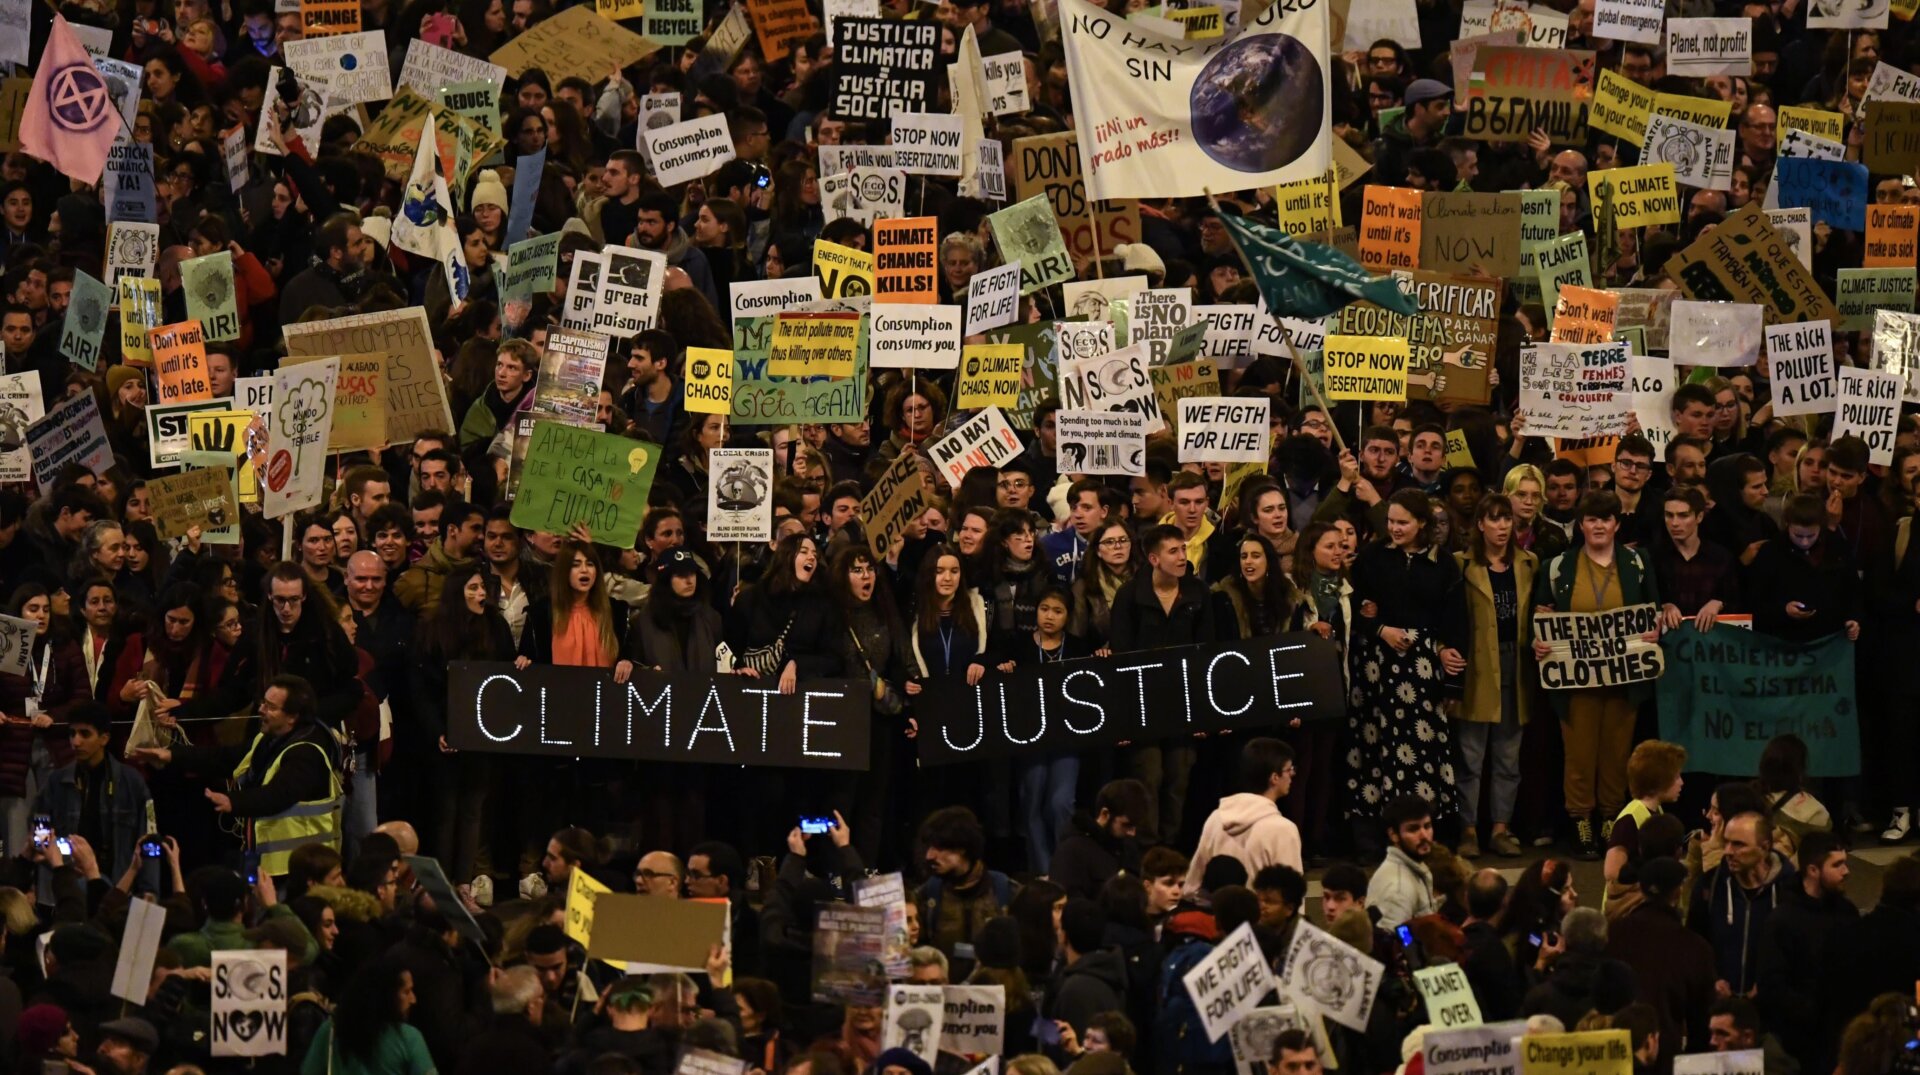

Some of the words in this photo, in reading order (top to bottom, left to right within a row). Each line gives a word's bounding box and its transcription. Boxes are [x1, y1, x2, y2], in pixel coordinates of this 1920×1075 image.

[304, 9, 358, 27] CHANGE
[649, 19, 701, 36] RECYCLE.
[1072, 14, 1112, 40] NO
[1597, 10, 1619, 26] global
[842, 22, 936, 44] JUSTICIA
[1531, 25, 1566, 47] UP!
[1670, 33, 1701, 56] Planet,
[1704, 33, 1718, 53] not
[1720, 31, 1748, 56] profit!
[841, 44, 934, 70] CLIMÁTICA
[985, 61, 1003, 79] kills
[1004, 60, 1021, 77] you
[1126, 58, 1172, 82] SIN
[838, 76, 925, 98] JUSTICIA
[1600, 76, 1630, 104] Change
[1630, 91, 1648, 113] your
[1892, 75, 1909, 98] Fat
[1126, 116, 1148, 129] un
[1468, 97, 1589, 141] ВЪГЛИЩА
[1594, 103, 1605, 118] no
[1605, 109, 1626, 128] your
[1691, 111, 1725, 130] NOW
[1780, 112, 1810, 131] Change
[1810, 118, 1827, 133] your
[652, 126, 723, 155] Consumption
[893, 129, 928, 147] STOP
[931, 131, 961, 148] NOW
[659, 148, 712, 172] consumes
[711, 143, 731, 161] you.
[839, 150, 854, 167] Fat
[855, 150, 873, 167] kills
[874, 152, 893, 170] you
[894, 152, 960, 170] DESERTIZATION!
[117, 173, 140, 192] YA!
[1619, 175, 1670, 194] CLIMATE
[1285, 194, 1311, 211] until
[1313, 193, 1331, 208] it's
[1366, 199, 1396, 214] Don't
[1397, 203, 1421, 221] wait
[1642, 197, 1677, 213] NOW!
[1284, 221, 1308, 236] too
[1872, 208, 1885, 227] Our
[1886, 209, 1914, 228] climate
[877, 227, 934, 246] CLIMATE
[1366, 226, 1392, 243] until
[1393, 226, 1411, 243] it's
[1520, 225, 1556, 241] future
[1360, 248, 1383, 265] too
[1385, 249, 1415, 268] late.
[1435, 235, 1495, 263] NOW
[1538, 241, 1584, 270] PLANET
[1867, 240, 1888, 257] make
[1888, 243, 1898, 256] us
[1898, 240, 1914, 258] sick
[817, 252, 849, 272] ENERGY
[848, 257, 868, 271] THAT
[877, 252, 934, 270] CHANGE
[877, 275, 934, 294] KILLS!
[971, 278, 990, 299] WE
[989, 270, 1019, 294] FIGTH
[1019, 255, 1071, 294] AIR!
[1553, 272, 1585, 293] OVER
[1841, 277, 1877, 294] CLIMATE
[1877, 277, 1915, 296] JUSTICE,
[604, 288, 650, 309] great
[735, 290, 813, 313] Consumption
[1138, 291, 1177, 304] There
[970, 305, 992, 326] FOR
[1150, 304, 1188, 324] NO
[1559, 300, 1590, 321] Don't
[1591, 308, 1614, 324] wait
[1838, 301, 1864, 316] global
[594, 311, 652, 333] poison!
[778, 320, 792, 337] The
[793, 322, 808, 338] rich
[808, 323, 831, 341] pollute
[831, 325, 854, 341] more,
[875, 314, 953, 337] Consumption
[1444, 318, 1481, 332] PARA
[154, 328, 179, 351] Don't
[179, 327, 202, 344] wait
[876, 339, 933, 353] consumes
[934, 338, 957, 354] you.
[1452, 329, 1497, 345] GANAR
[1769, 334, 1794, 353] THE
[62, 331, 98, 367] AIR!
[770, 344, 785, 361] thus
[785, 344, 810, 365] killing
[810, 347, 827, 361] over
[828, 347, 854, 363] others.
[162, 357, 185, 374] until
[185, 355, 199, 371] it's
[982, 357, 1020, 373] CLIMATE
[1326, 351, 1366, 368] STOP
[1369, 352, 1405, 371] NOW
[1776, 354, 1830, 381] POLLUTE
[162, 383, 181, 399] too
[181, 378, 209, 396] late.
[961, 380, 992, 398] CHAOS,
[993, 379, 1021, 397] NOW!
[1327, 376, 1404, 395] DESERTIZATION!
[1782, 388, 1796, 406] A
[1801, 376, 1836, 401] LOT.
[1841, 377, 1863, 395] THE
[1059, 415, 1089, 430] Spending
[1090, 418, 1103, 428] too
[1104, 418, 1122, 428] much
[1130, 418, 1143, 428] bad
[1185, 406, 1211, 424] WE
[1215, 405, 1266, 425] FIGTH
[1841, 402, 1893, 428] POLLUTE
[935, 439, 964, 464] NO
[966, 413, 993, 444] HAY
[1060, 429, 1070, 440] for
[1070, 431, 1083, 442] you,
[1083, 428, 1101, 443] people
[1101, 429, 1112, 439] and
[1113, 428, 1143, 440] climate.
[1184, 432, 1217, 451] FOR
[1220, 431, 1262, 452] LIFE!
[713, 450, 742, 458] GLOBAL
[745, 450, 770, 458] CRISIS
[861, 453, 918, 526] SILENCE
[875, 491, 925, 556] OPTION
[1533, 616, 1574, 642] THE
[1575, 605, 1658, 640] EMPEROR
[1570, 638, 1601, 660] HAS
[1602, 635, 1627, 658] NO
[1542, 649, 1661, 689] CLOTHES
[1700, 677, 1724, 695] EL
[941, 645, 1314, 752] JUSTICE
[476, 673, 845, 758] CLIMATE
[1704, 709, 1733, 741] NO
[1195, 973, 1218, 997] WE
[1218, 937, 1253, 977] FIGTH
[1422, 971, 1466, 999] PLANET
[1206, 993, 1235, 1026] FOR
[1440, 1003, 1474, 1028] OVER
[1528, 1039, 1575, 1067] Change
[1576, 1042, 1604, 1066] your
